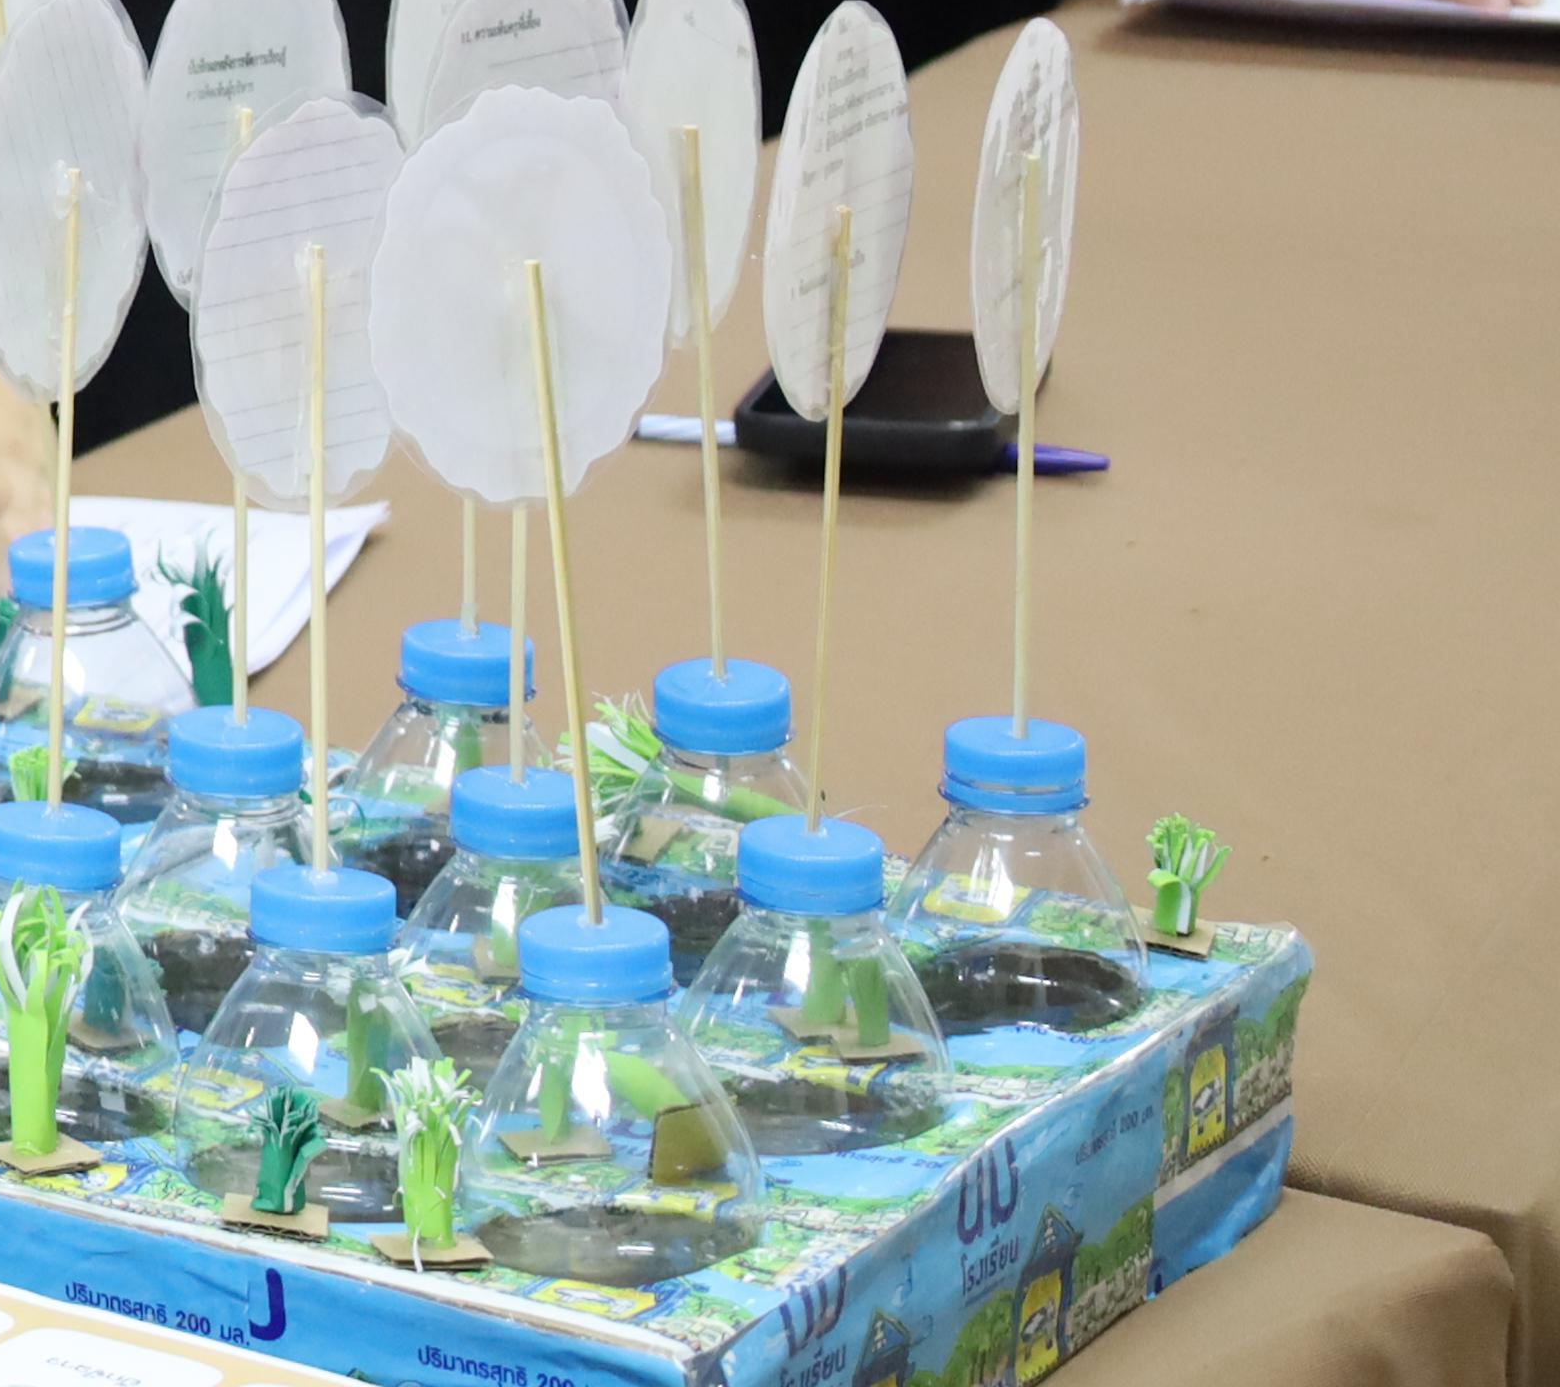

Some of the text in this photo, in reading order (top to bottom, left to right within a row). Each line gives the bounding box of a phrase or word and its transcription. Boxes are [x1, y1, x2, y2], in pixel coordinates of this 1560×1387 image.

[960, 1231, 1019, 1297] โรงเรียน
[65, 1280, 251, 1346] ปริมาตรสุทธิ 200 มล.
[418, 1345, 528, 1387] ปริมาตรสุทธิ
